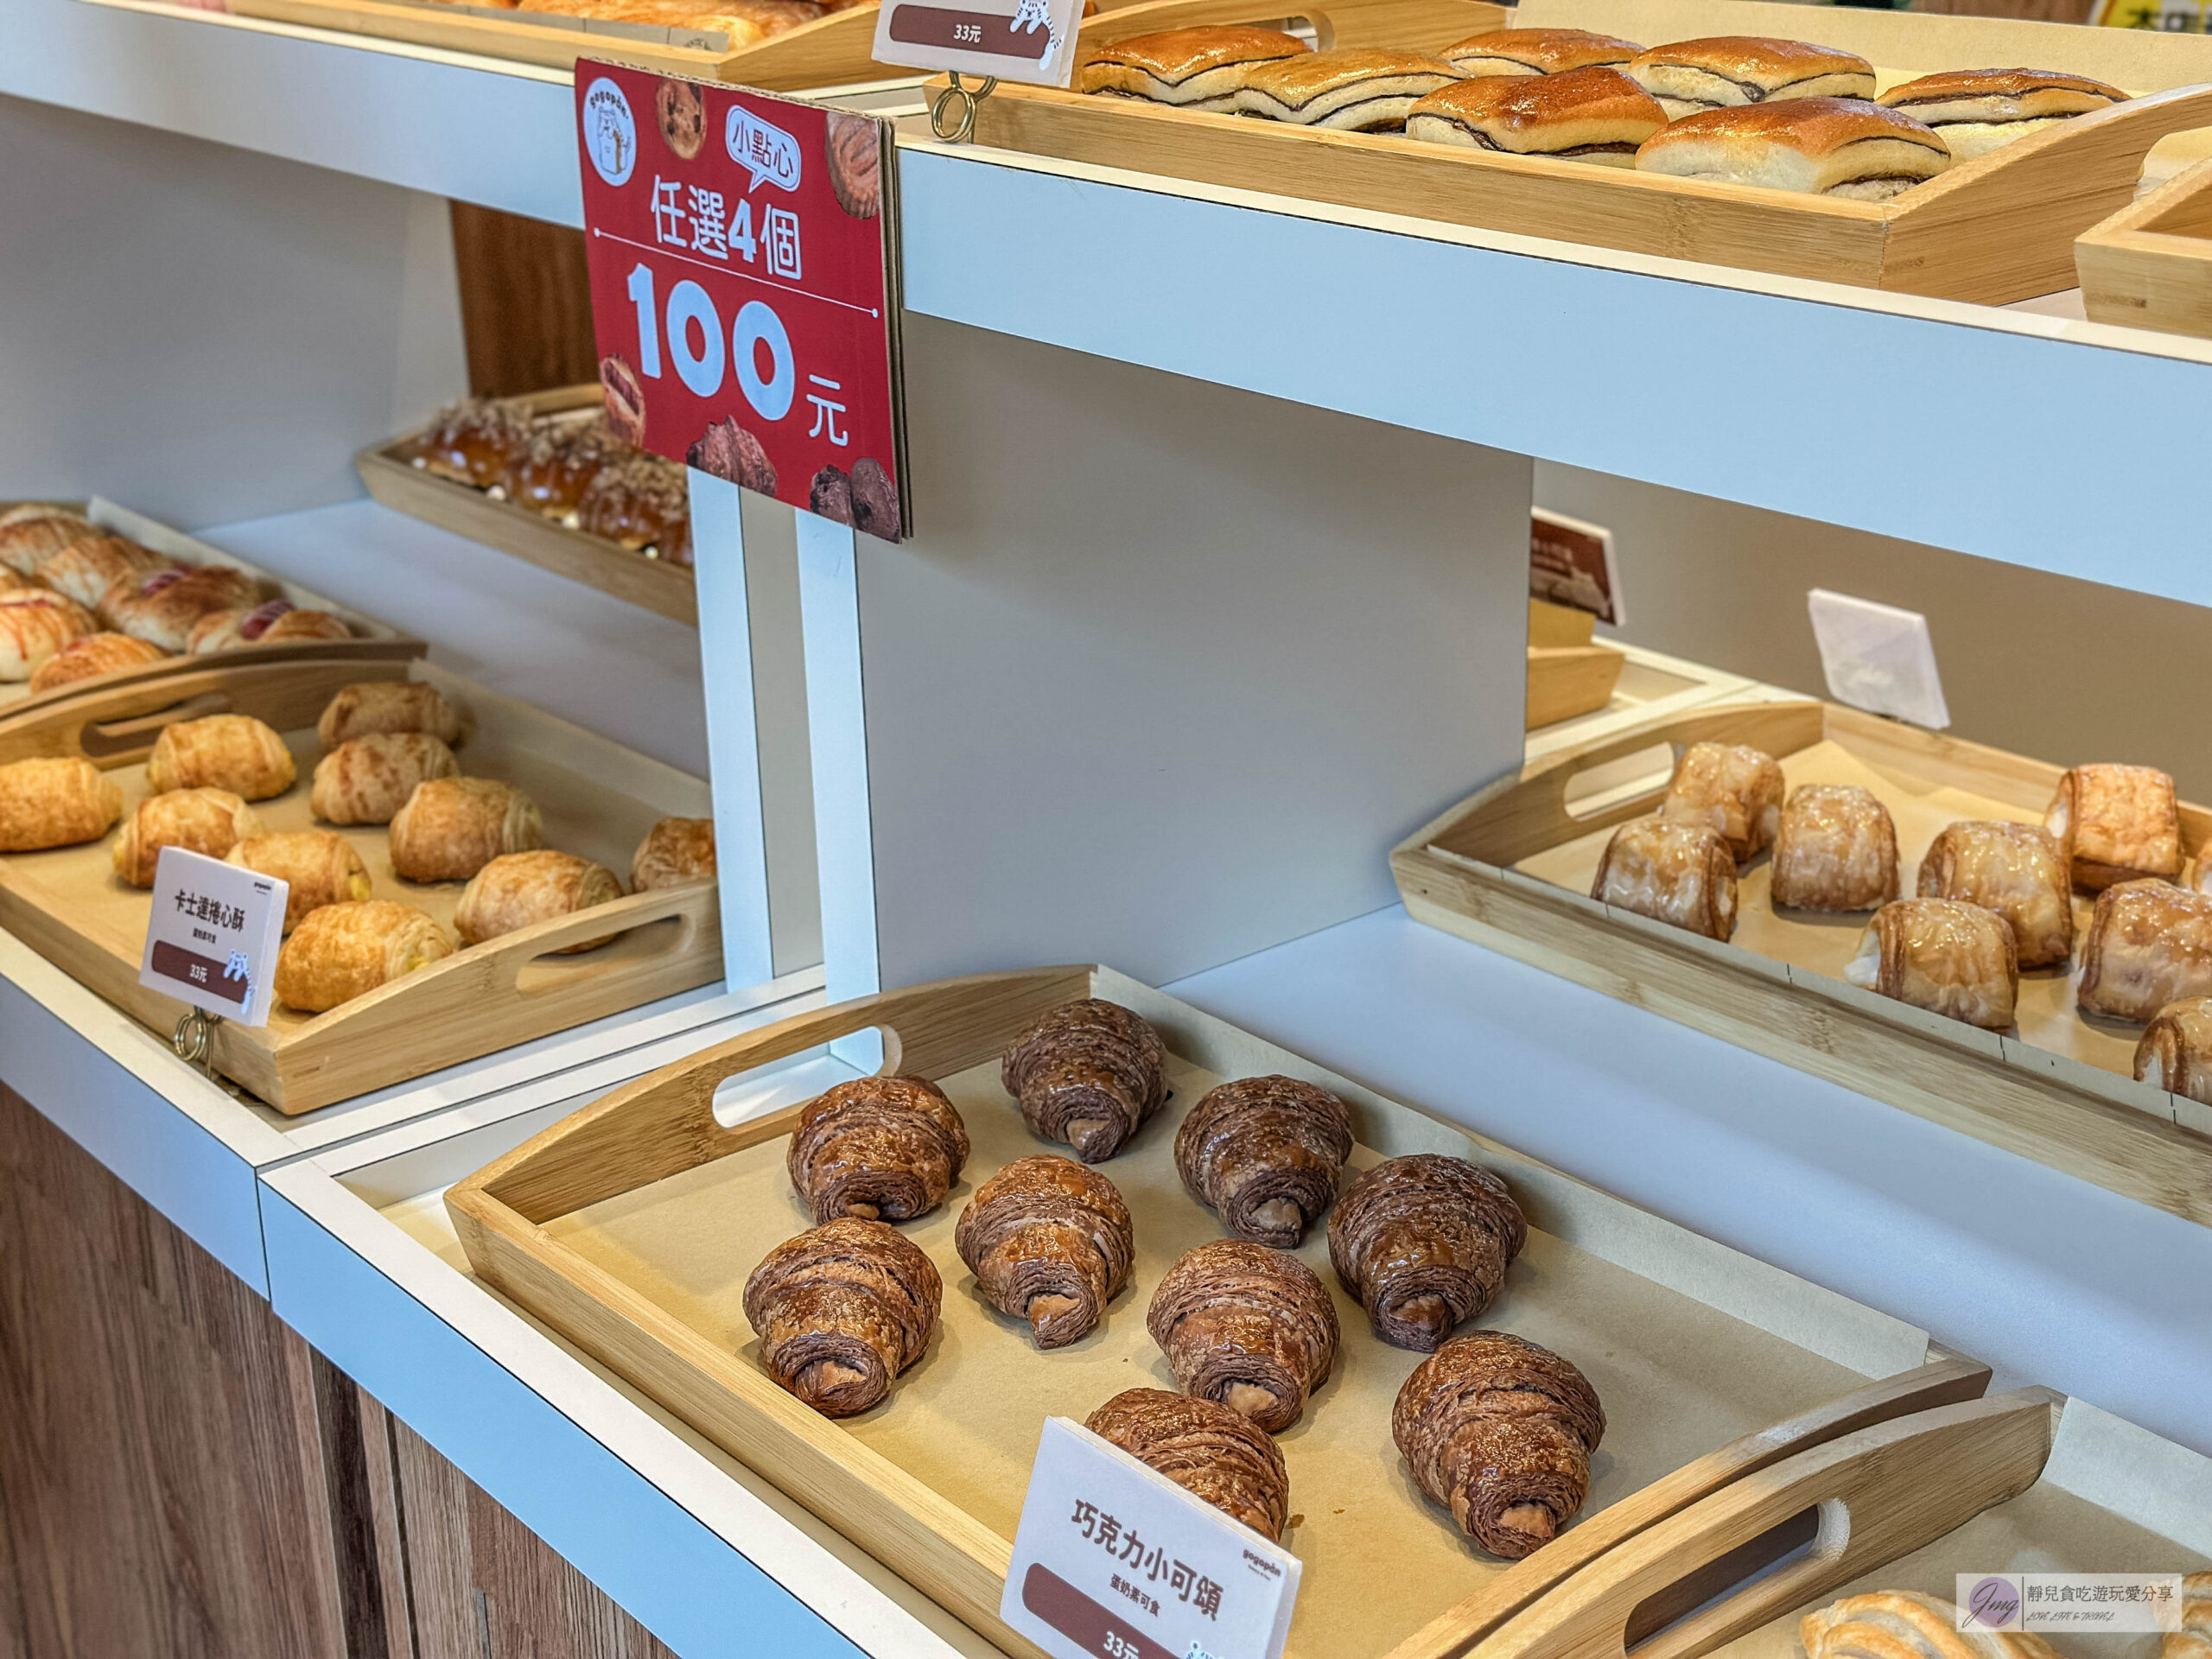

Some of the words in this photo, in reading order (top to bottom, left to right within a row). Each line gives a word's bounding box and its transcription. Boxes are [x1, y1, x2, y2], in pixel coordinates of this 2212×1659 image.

[953, 23, 982, 43] 33元
[730, 121, 795, 180] 小點心
[650, 174, 802, 281] 任選4個
[626, 261, 849, 447] 100元
[189, 963, 208, 983] 33元
[1071, 1498, 1224, 1622] 巧克力小可頌
[1109, 1573, 1161, 1618] 蛋奶素可食
